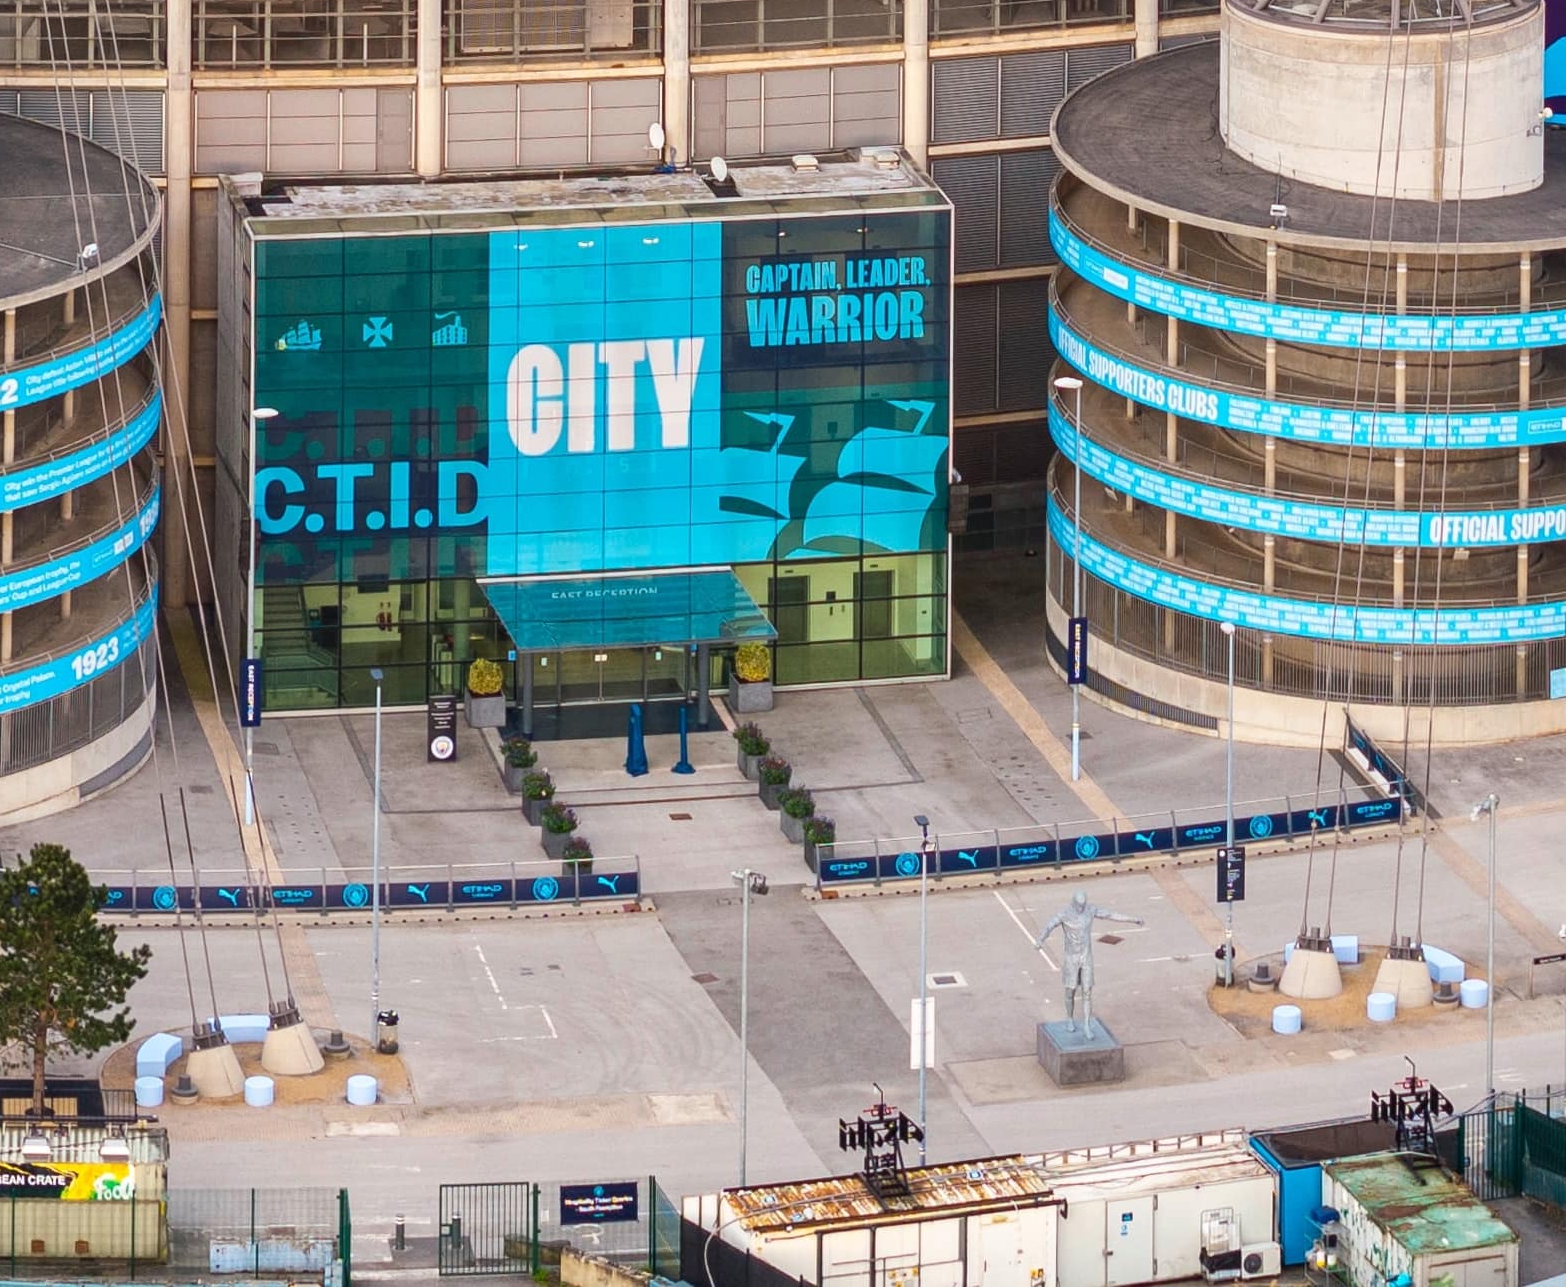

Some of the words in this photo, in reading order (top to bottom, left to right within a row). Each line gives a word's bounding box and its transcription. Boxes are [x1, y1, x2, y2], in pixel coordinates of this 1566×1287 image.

[747, 263, 843, 293] CAPTAIN,
[846, 257, 932, 287] LEADER,
[747, 291, 925, 348] WARRIOR
[1089, 349, 1165, 406] SUPPORTERS
[1167, 380, 1218, 421] CLUBS
[505, 338, 704, 457] CITY
[1429, 515, 1507, 543] OFFICIAL
[71, 637, 119, 680] 1923
[1357, 803, 1392, 814] ETIHAD
[1185, 826, 1222, 837] ETIHAD
[1009, 846, 1046, 856] ETIHAD
[830, 862, 867, 871] ETIHAD
[273, 889, 312, 898] ETIHAD
[462, 884, 502, 893] ETIHAD
[28, 1175, 66, 1187] CRATE
